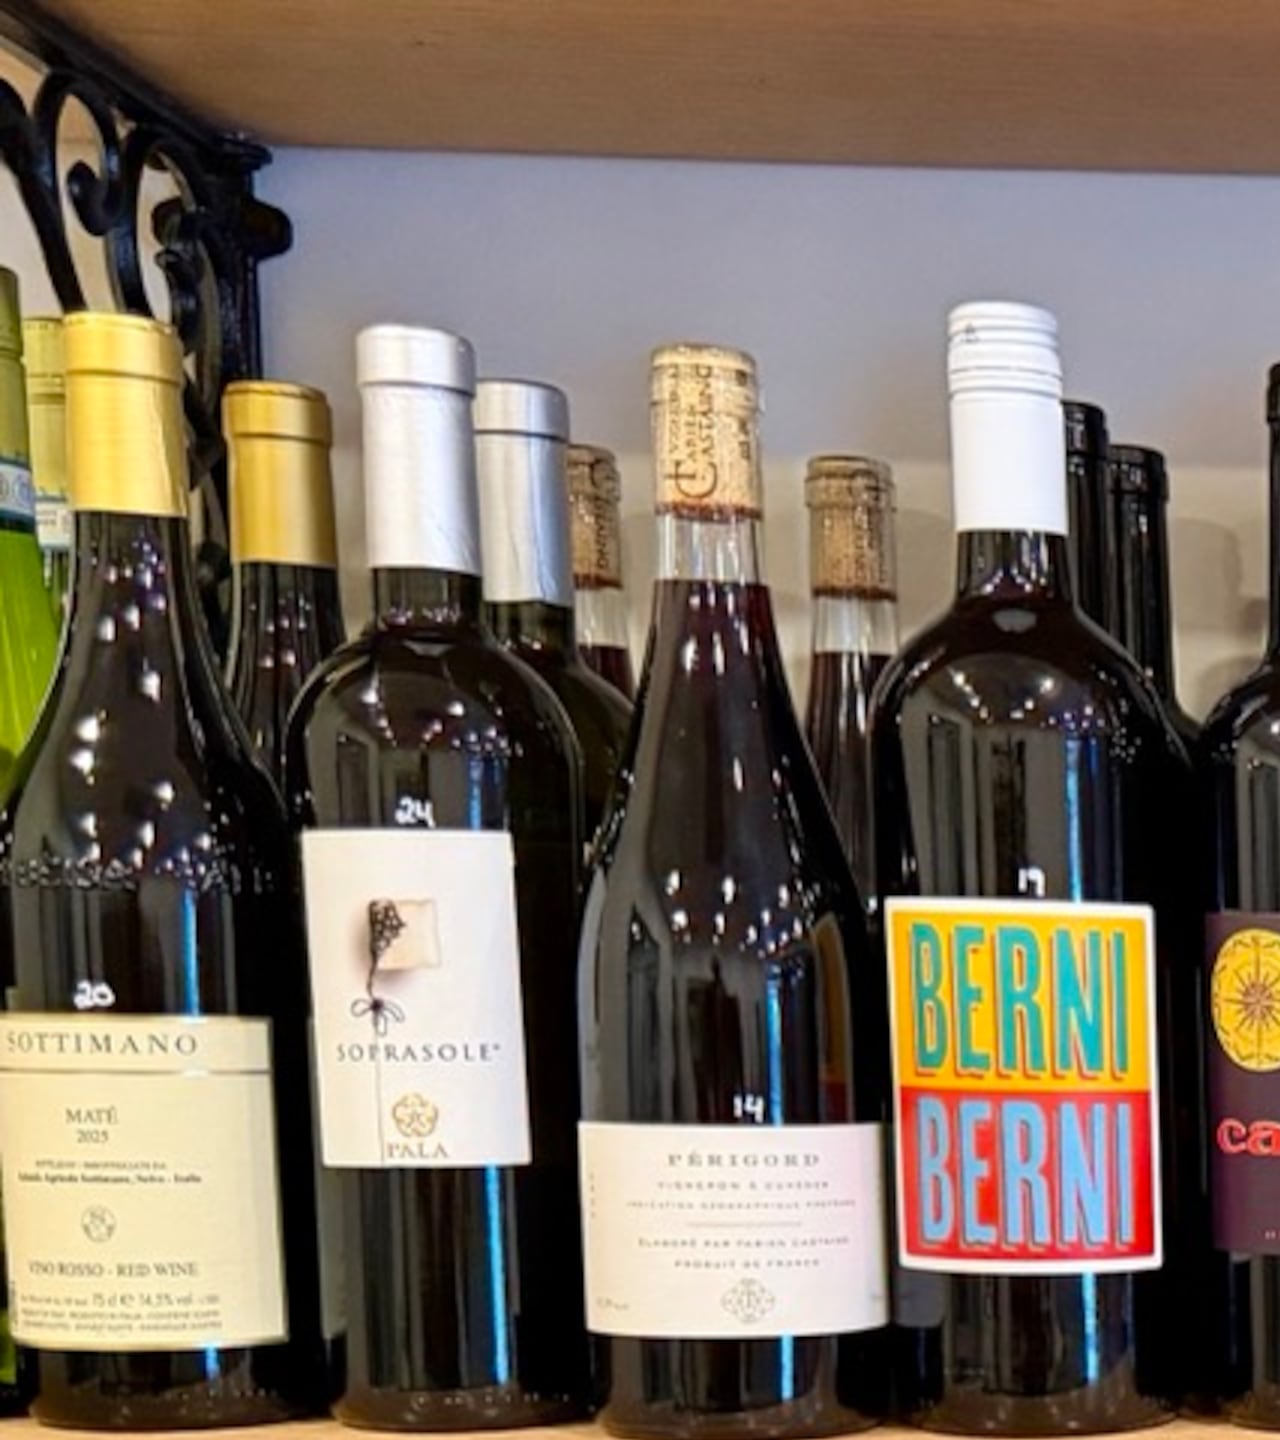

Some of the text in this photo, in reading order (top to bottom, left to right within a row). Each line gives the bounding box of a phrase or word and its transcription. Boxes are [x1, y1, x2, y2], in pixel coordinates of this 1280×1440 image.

[908, 922, 1129, 1080] BERNI
[387, 1142, 448, 1159] PALA
[917, 1093, 1136, 1250] BERNI
[153, 1261, 199, 1277] WINE
